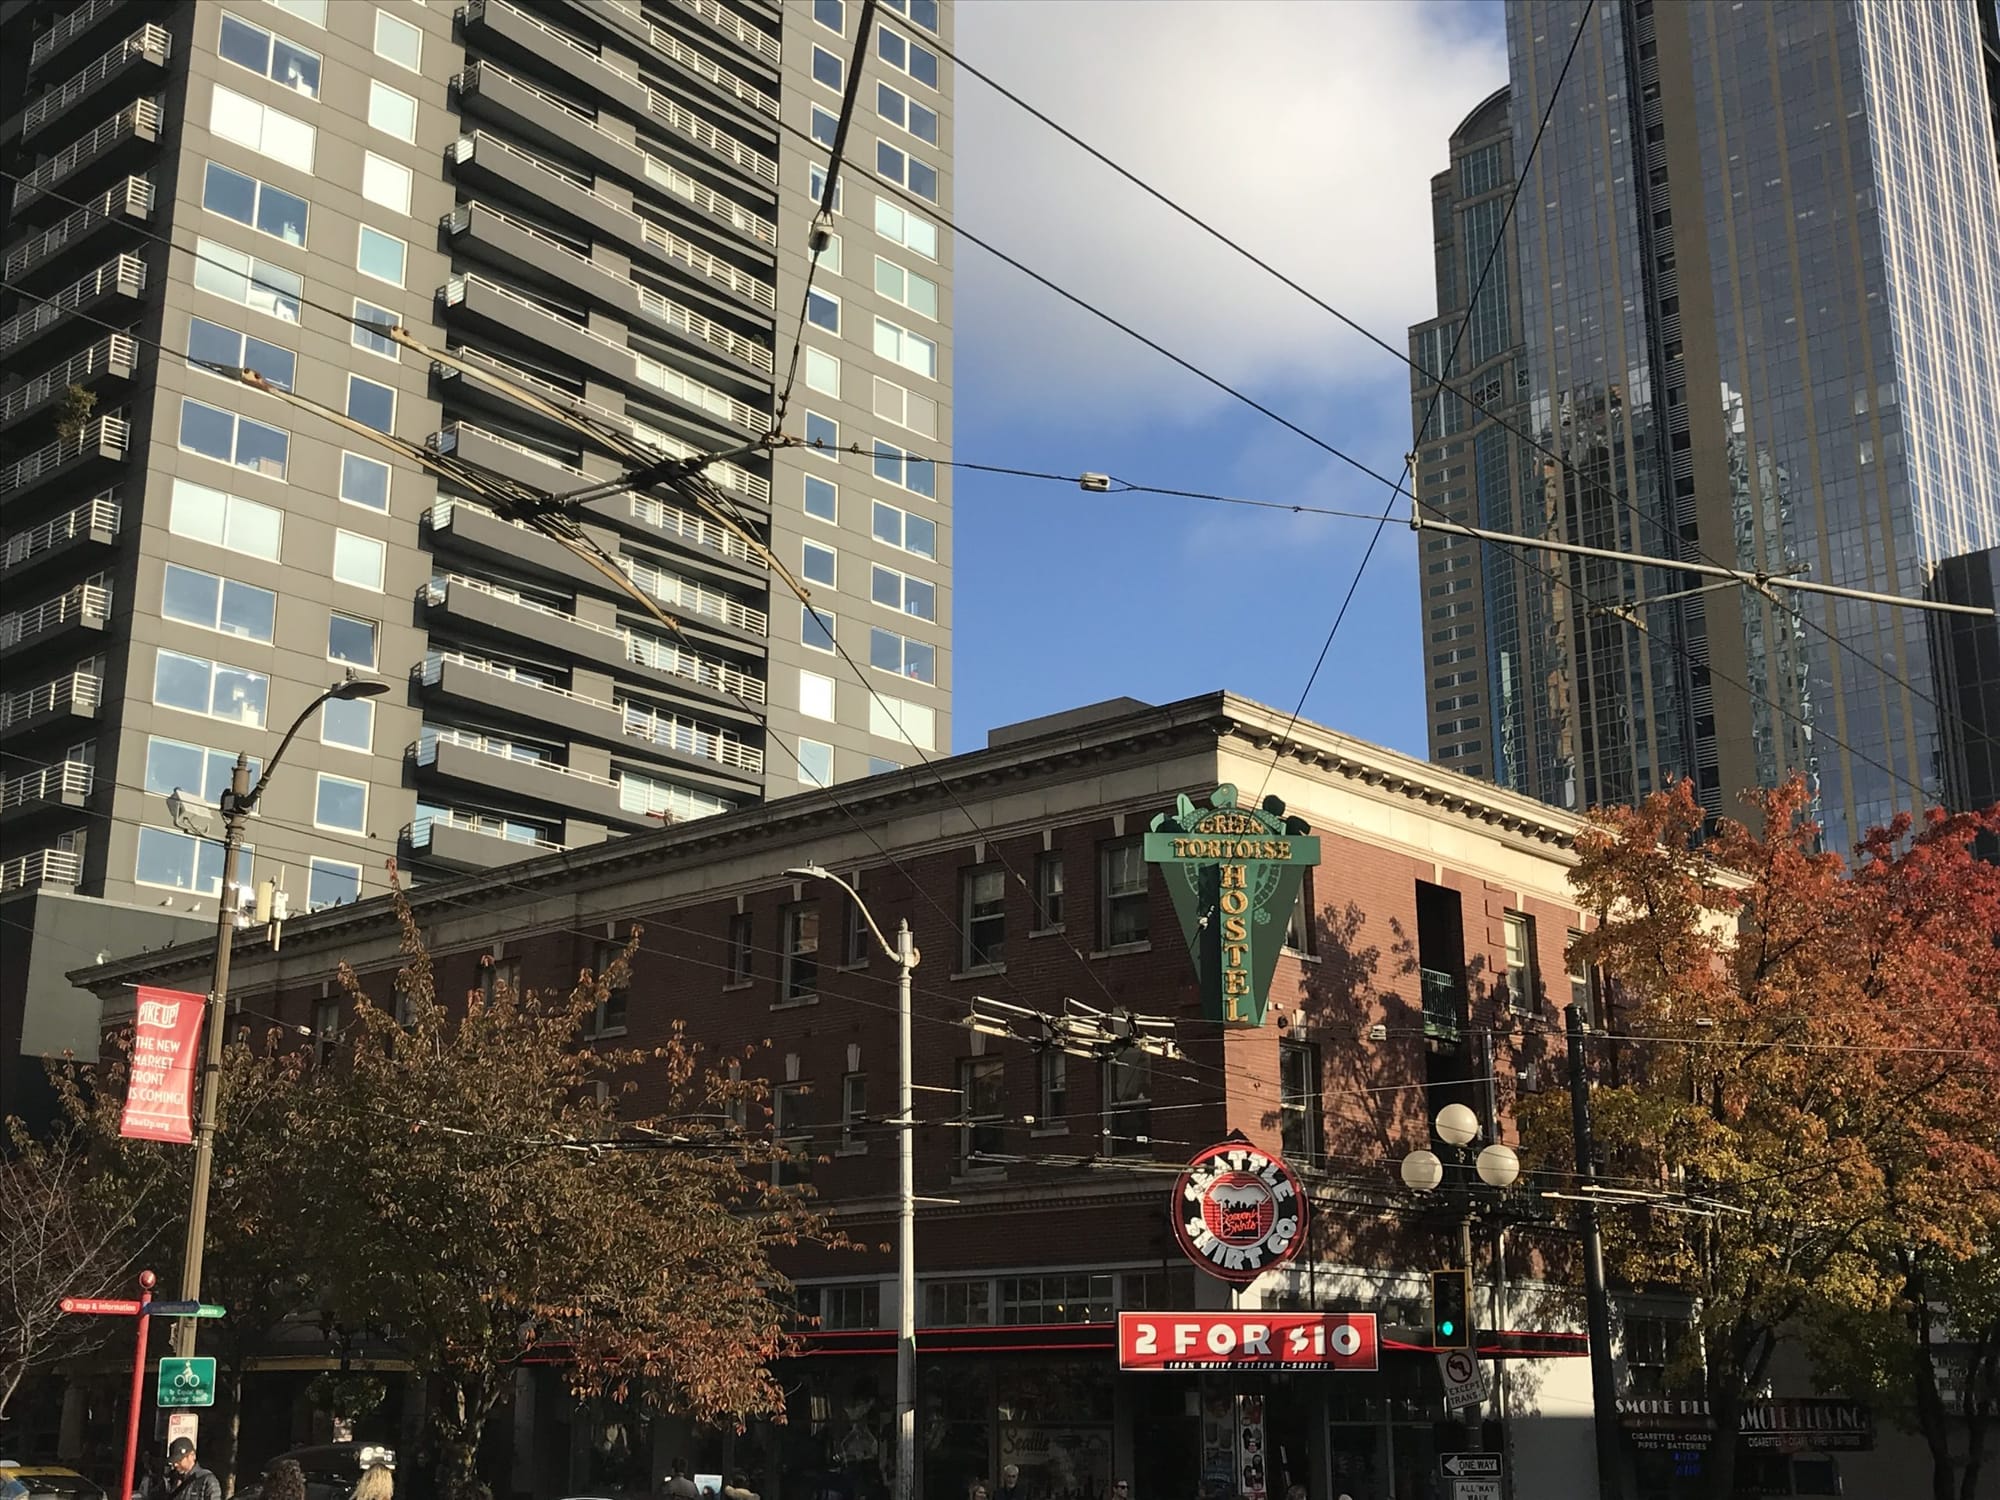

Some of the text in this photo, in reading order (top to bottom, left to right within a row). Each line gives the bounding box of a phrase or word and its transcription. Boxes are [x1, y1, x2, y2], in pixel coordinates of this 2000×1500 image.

[1199, 815, 1265, 834] GREEN
[1173, 838, 1293, 860] TORTOISE
[1219, 864, 1250, 1023] HOSTEL
[138, 1003, 179, 1026] PIKE UP!
[136, 1035, 181, 1054] THE NEW
[133, 1055, 175, 1070] MARKET
[131, 1070, 165, 1086] FRONT
[128, 1086, 185, 1105] IS COMING!
[1185, 1214, 1299, 1271] SHIRT CO.
[98, 1302, 137, 1312] information
[1135, 1323, 1362, 1357] 2 FOR $10
[1449, 1381, 1480, 1395] EXCEPT
[1615, 1398, 1711, 1415] SMOKE PLU
[1631, 1432, 1713, 1442] CIGARETTES CIGARS
[1637, 1441, 1707, 1451] PIPES BATTERIES
[1459, 1461, 1495, 1470] ONE WAY
[1460, 1485, 1495, 1493] ALL WAY
